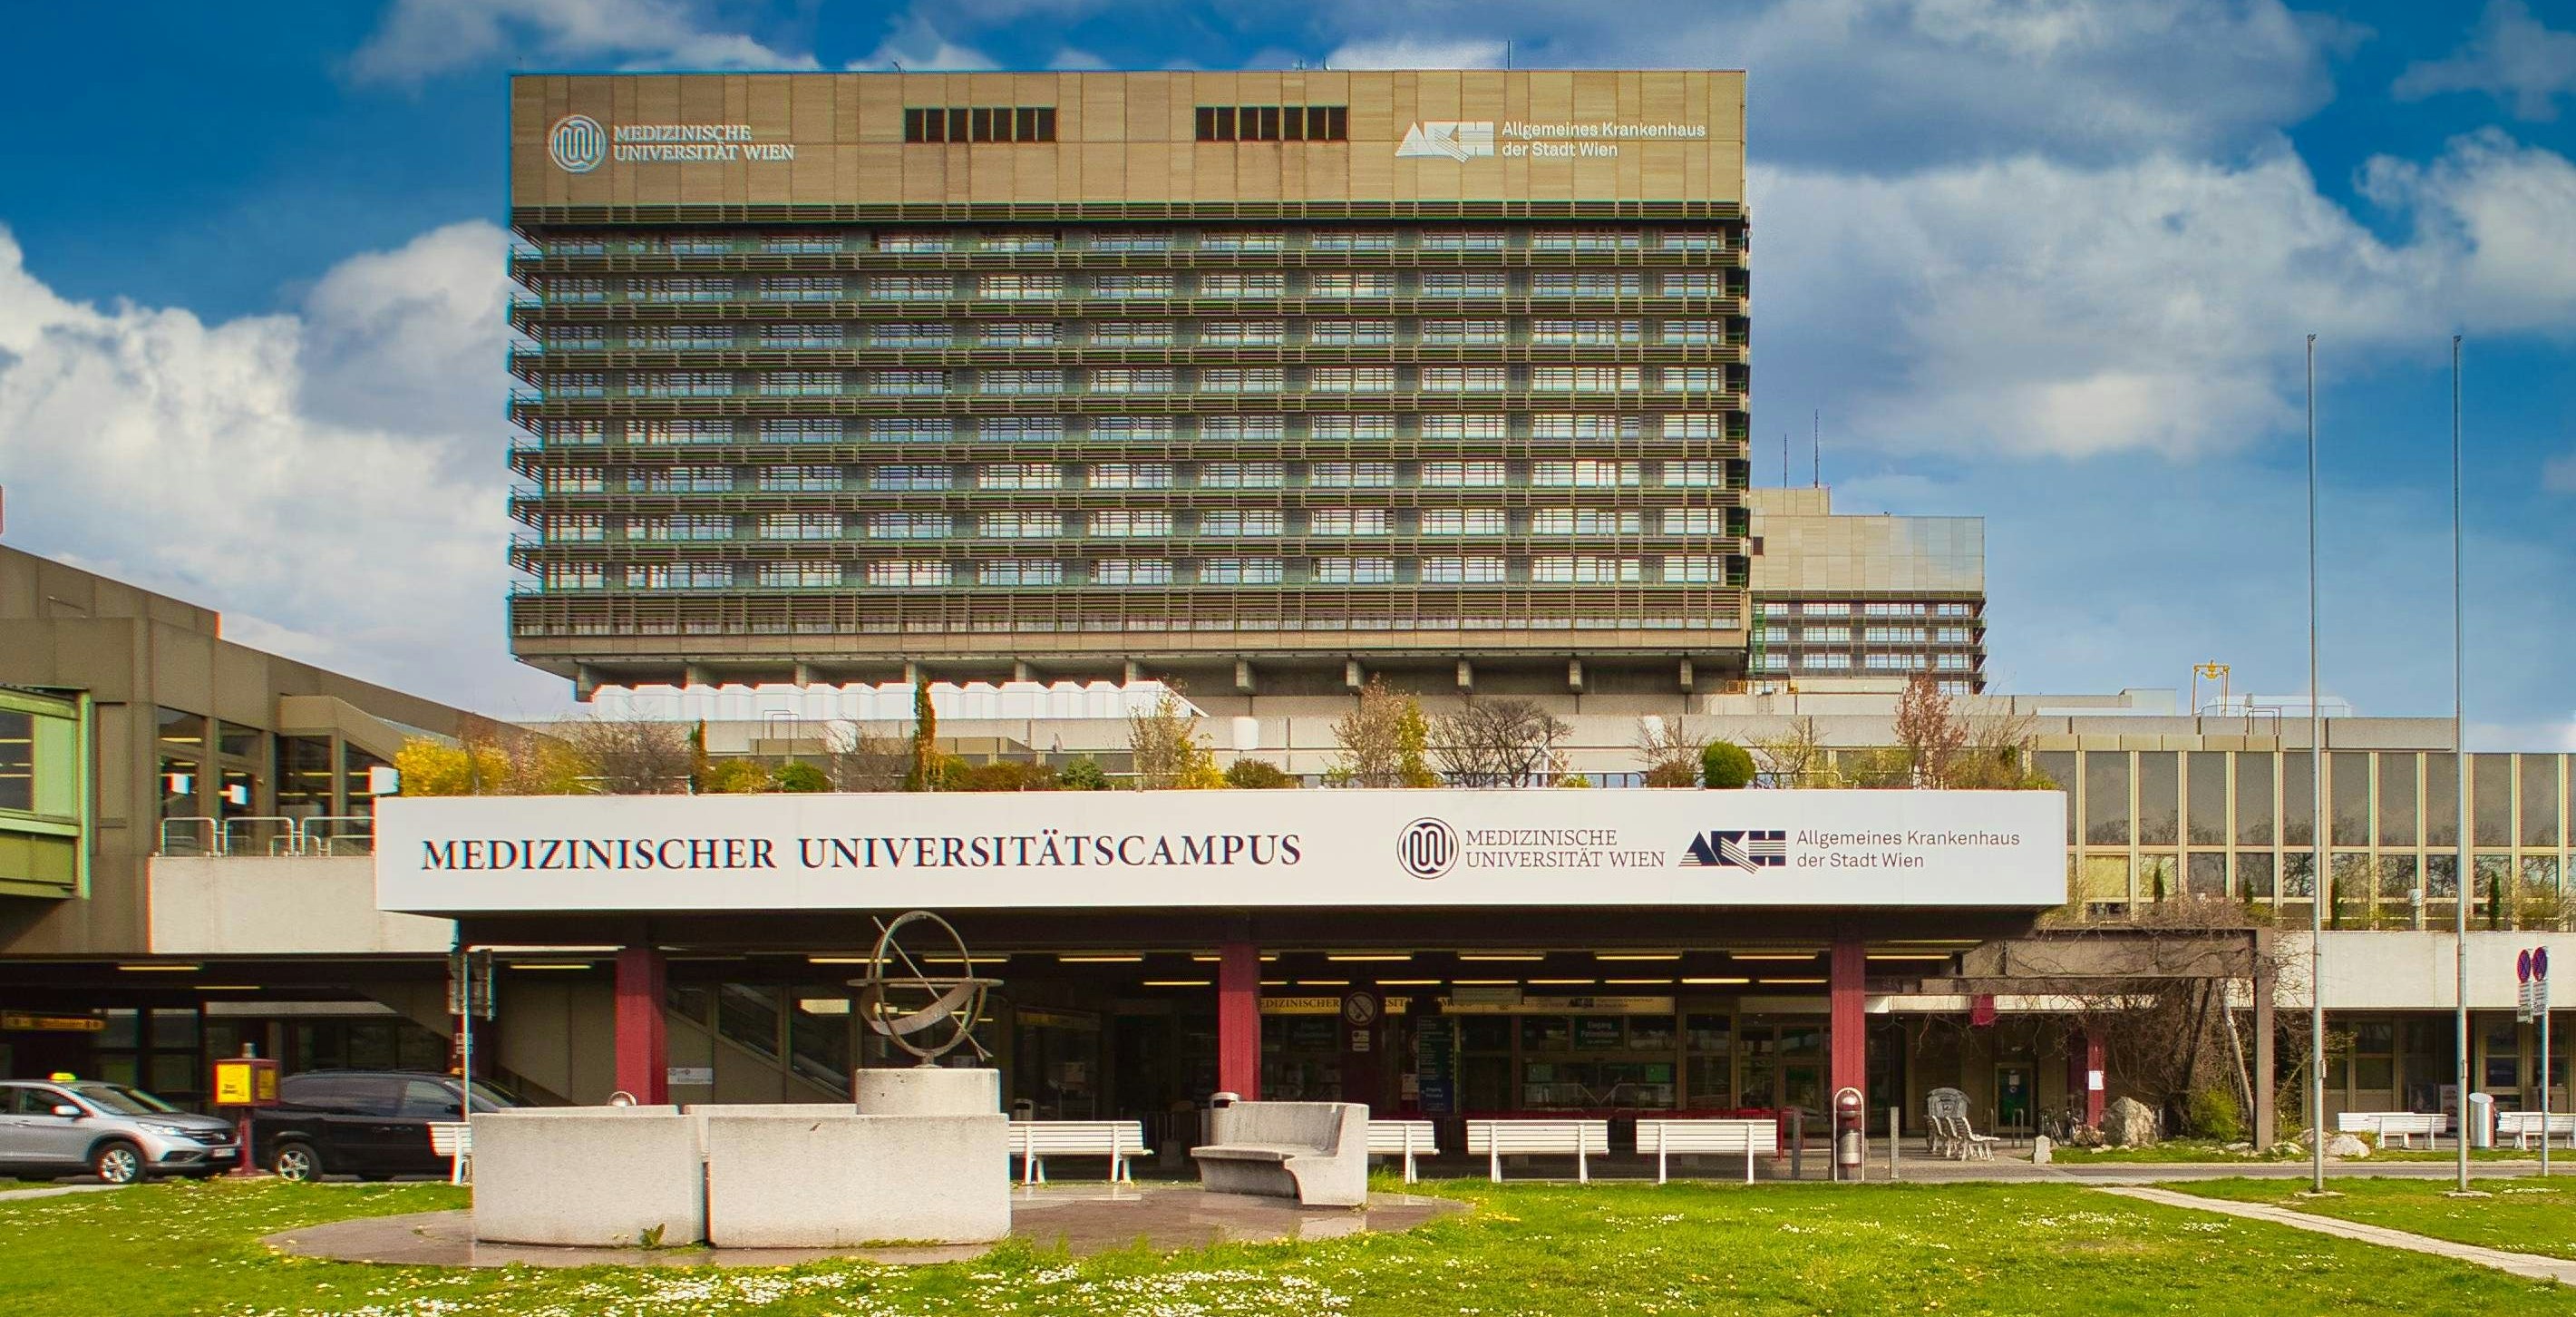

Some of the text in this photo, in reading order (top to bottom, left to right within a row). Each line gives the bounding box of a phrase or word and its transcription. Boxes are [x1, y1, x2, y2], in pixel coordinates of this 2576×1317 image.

[613, 124, 752, 142] MEDIZINISCHE
[1502, 121, 1706, 140] Allgemeines Krankenhaus
[613, 141, 796, 161] UNIVERSITÄT WIEN
[1502, 141, 1619, 157] der Stadt Wien
[1465, 829, 1618, 846] MEDIZINISCHE
[1796, 830, 2020, 849] Allgemeines Krankenhaus
[421, 829, 1302, 870] MEDIZINISCHER UNIVERSITÄTSCAMPUS
[1465, 848, 1666, 868] UNIVERSITÄT WIEN
[1797, 853, 1924, 868] der Stadt Wien
[1260, 999, 1339, 1008] EDIZINISCHER
